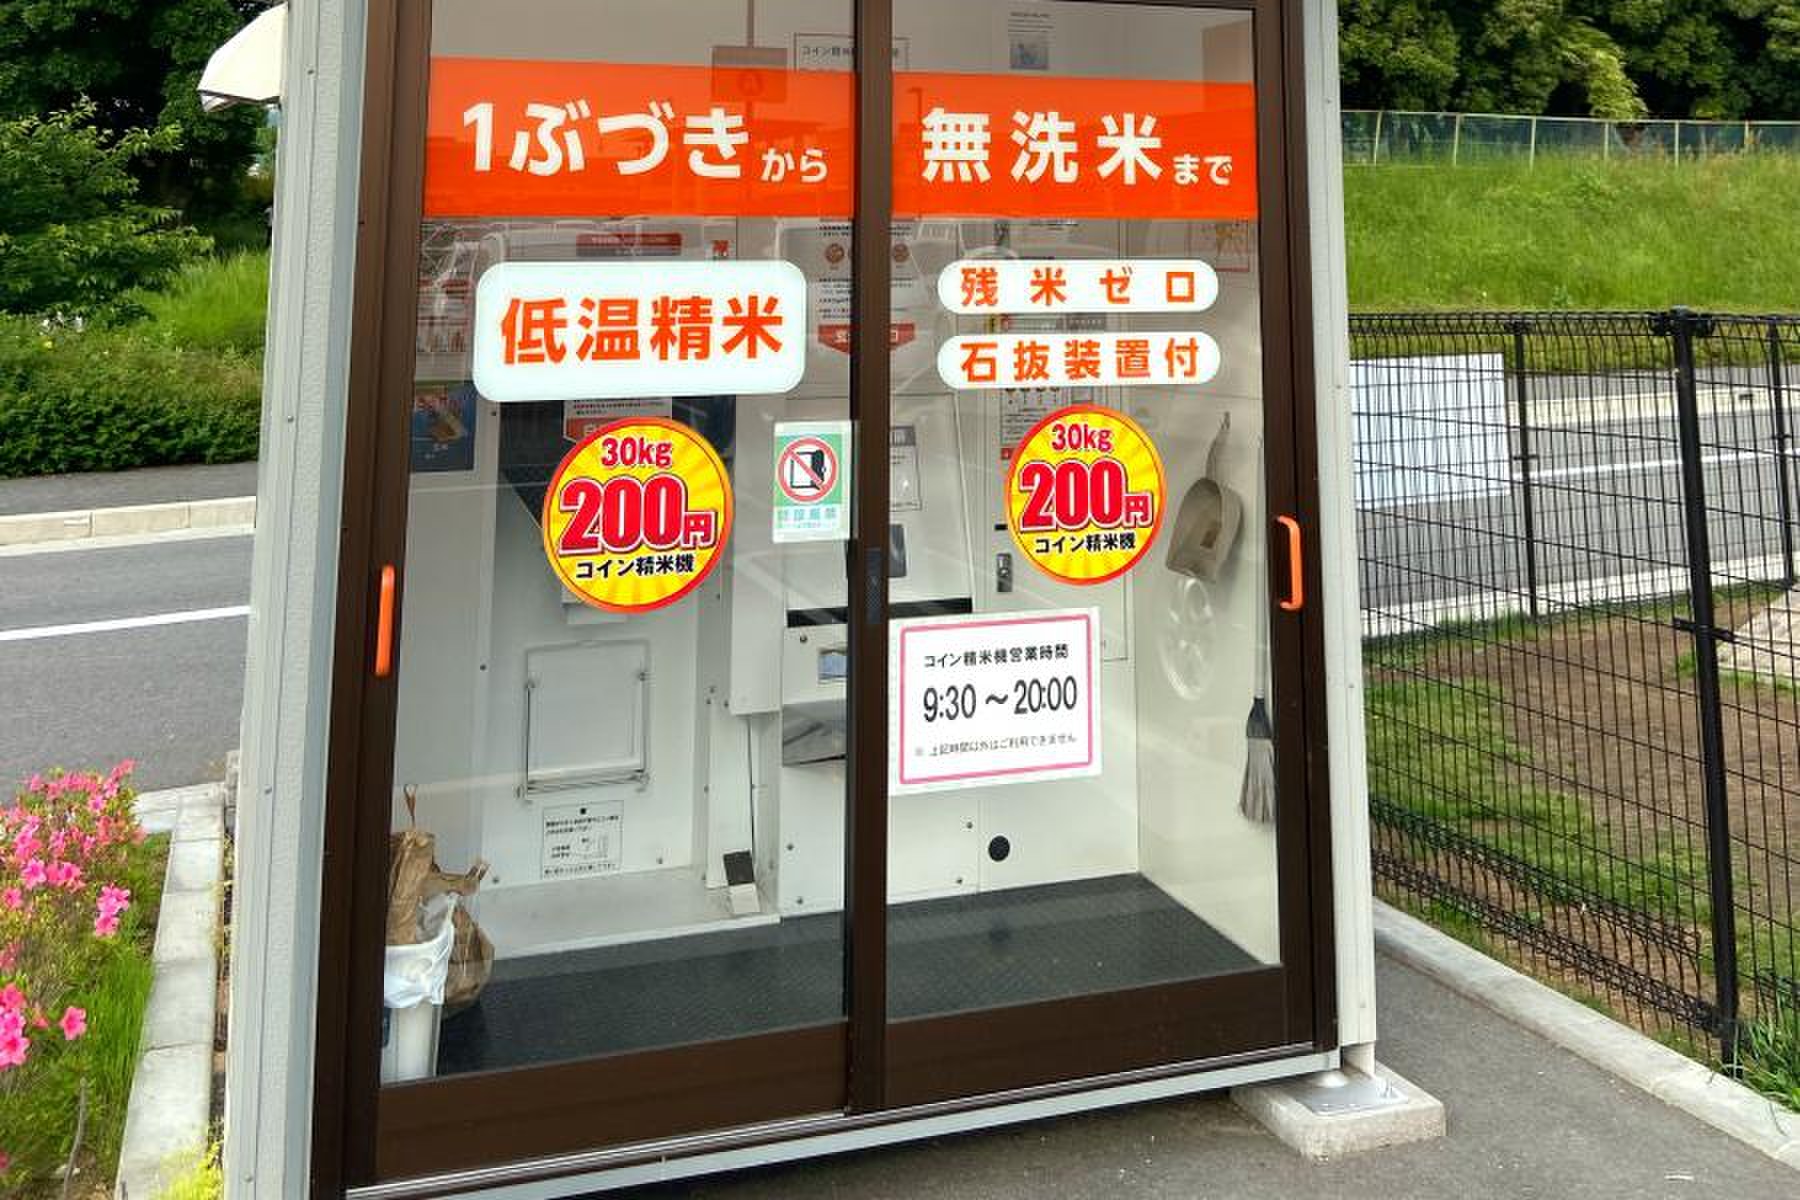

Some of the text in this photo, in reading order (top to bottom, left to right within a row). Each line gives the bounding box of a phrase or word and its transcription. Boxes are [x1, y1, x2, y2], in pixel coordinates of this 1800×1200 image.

[960, 266, 1196, 306] 残米ゼロ
[501, 295, 783, 365] 低温精米
[960, 338, 1198, 383] 石抜装置付
[601, 436, 672, 467] 30kg
[1051, 423, 1113, 452] 30kg
[1020, 459, 1153, 532] 200円
[560, 474, 717, 556] 200円
[1035, 532, 1136, 554] コイン精米機
[576, 552, 695, 579] コイン精米機
[924, 643, 1069, 669] コイン精米機営業時間
